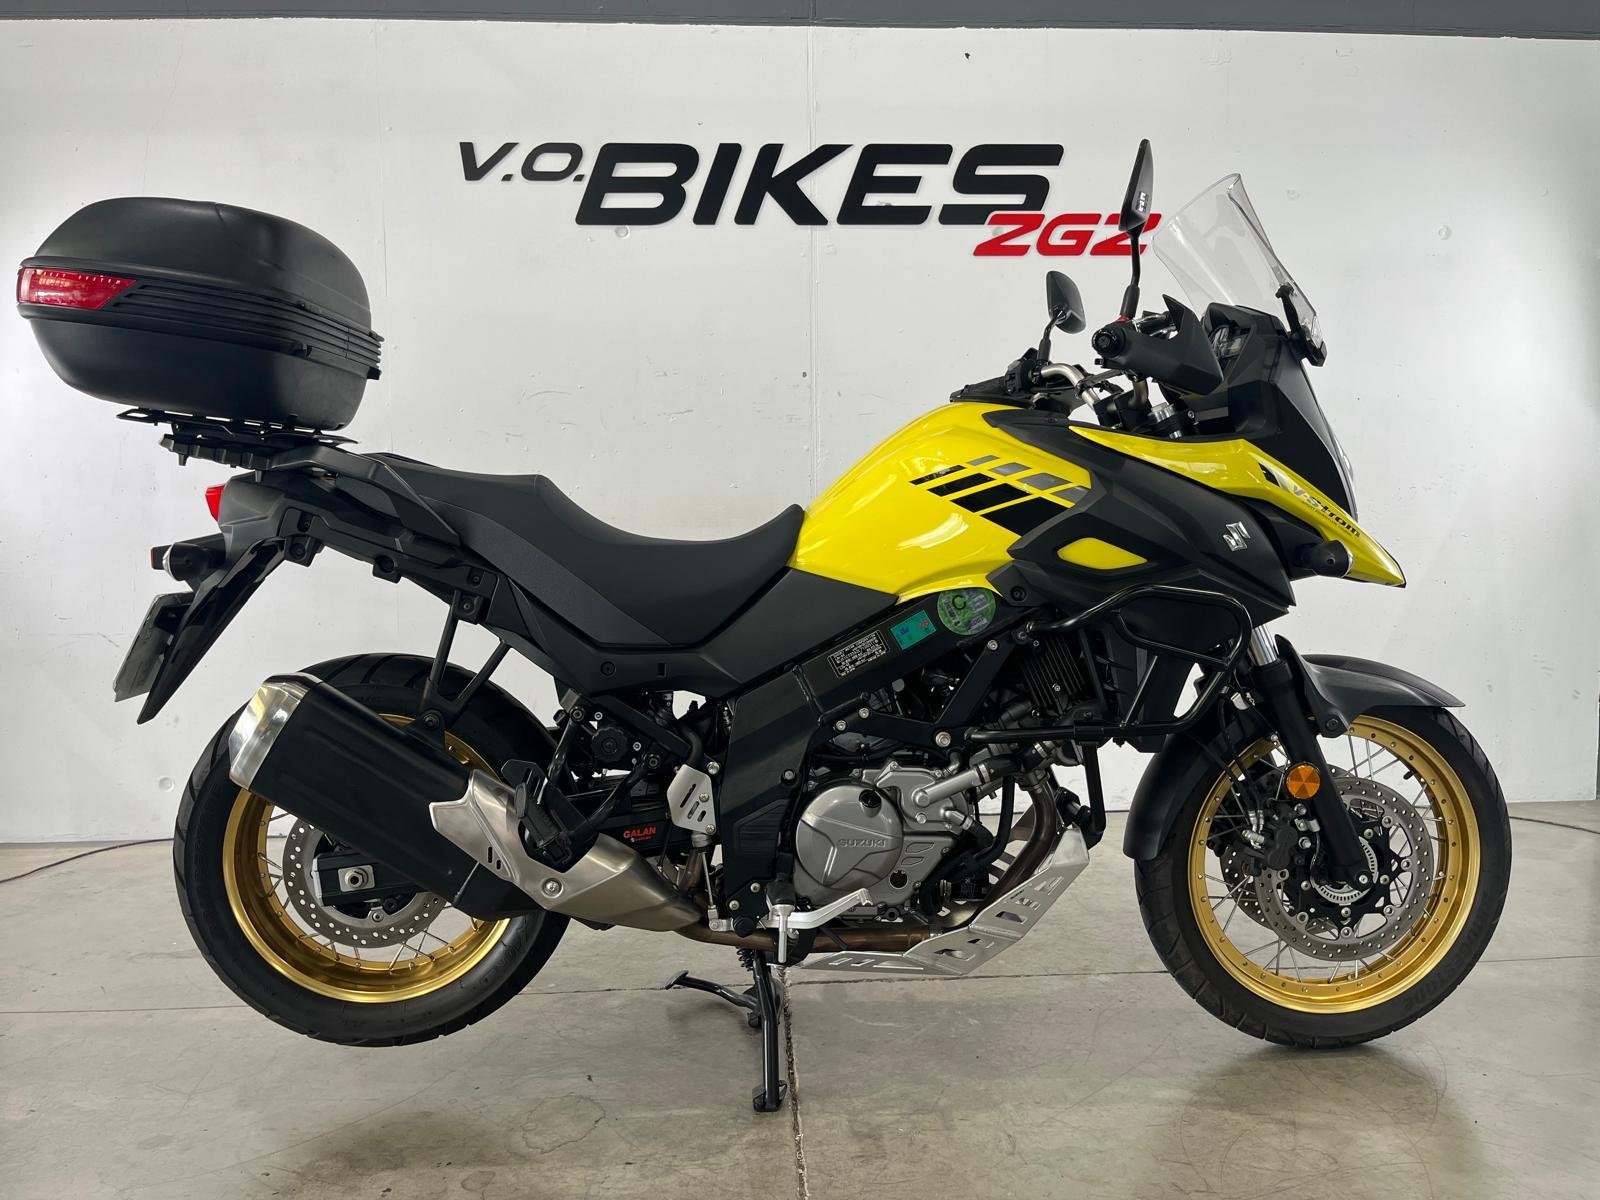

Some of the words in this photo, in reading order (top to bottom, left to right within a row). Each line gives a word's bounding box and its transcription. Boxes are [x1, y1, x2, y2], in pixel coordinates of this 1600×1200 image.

[460, 142, 585, 181] V.O.
[576, 143, 1064, 225] BIKES
[623, 826, 657, 838] GALAN
[839, 839, 886, 848] SUZUKI
